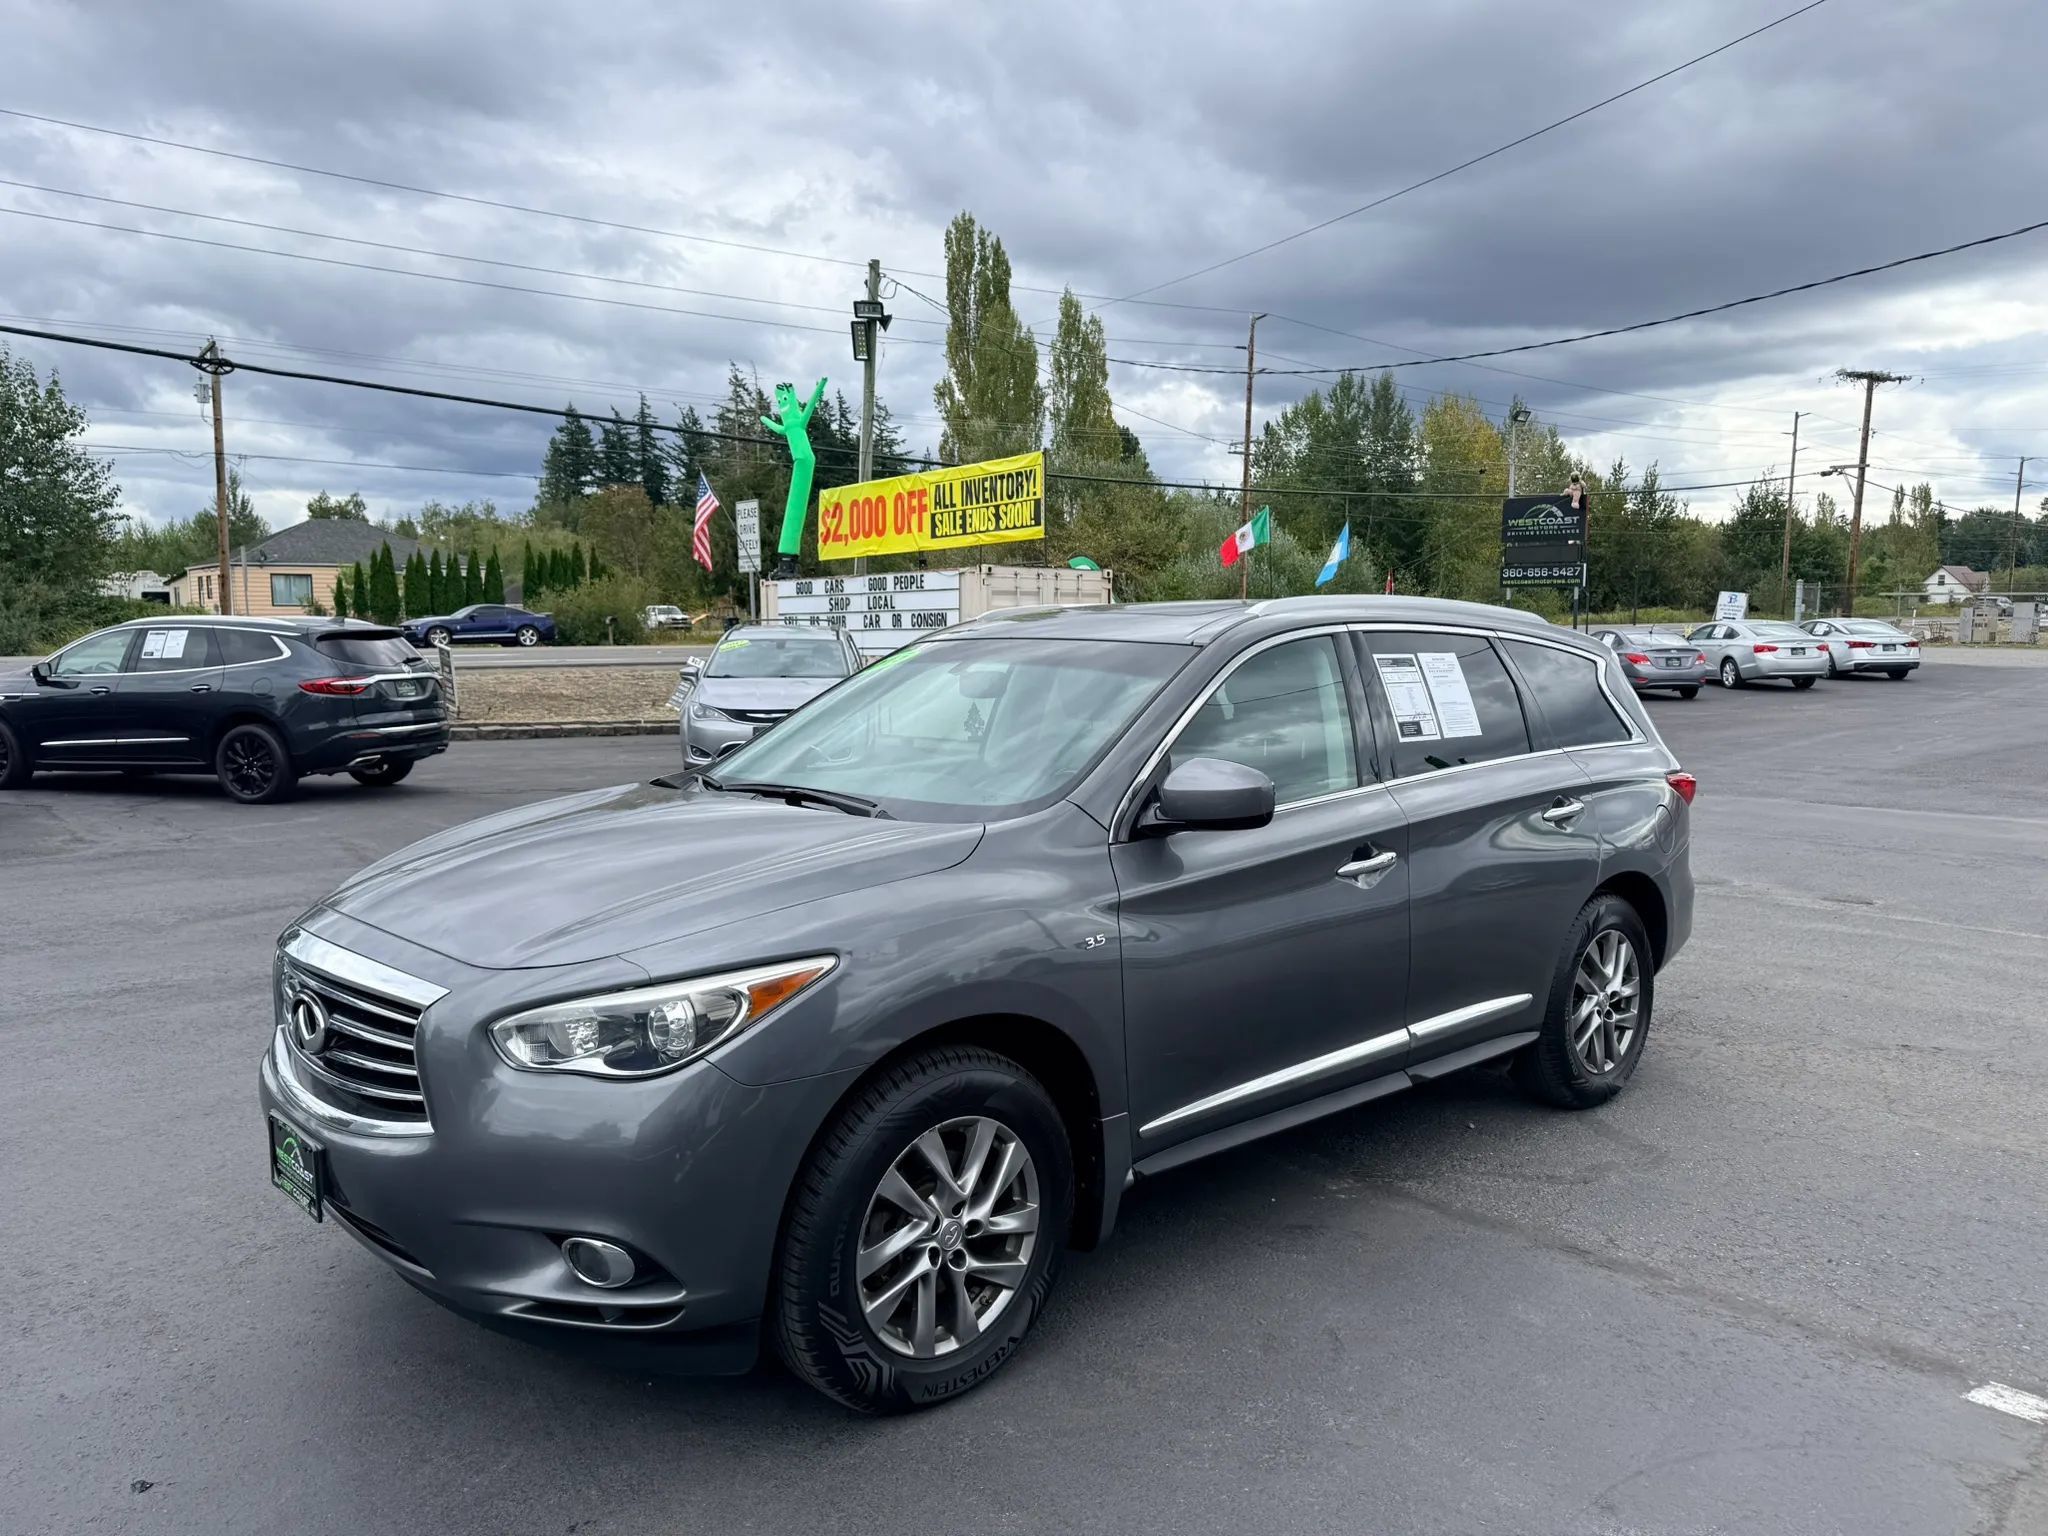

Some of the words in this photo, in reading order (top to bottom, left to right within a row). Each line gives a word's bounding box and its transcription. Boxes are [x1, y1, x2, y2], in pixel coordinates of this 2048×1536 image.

[934, 483, 956, 511] ALL
[960, 468, 1037, 507] INVENTORY!
[737, 507, 757, 519] PLEASE
[820, 495, 887, 546] $2,000
[893, 488, 928, 535] OFF
[935, 509, 963, 537] SALE
[965, 506, 996, 533] ENDS
[999, 500, 1036, 530] SOON!
[1508, 516, 1580, 526] WESTCOAST
[795, 581, 813, 595] GOOD
[824, 579, 845, 594] CARS
[868, 577, 888, 592] GOOD
[893, 574, 925, 590] PEOPLE
[828, 597, 851, 612] SHOP
[867, 595, 896, 610] LOCAL
[863, 614, 881, 629] CAR
[891, 613, 902, 628] OR
[910, 612, 948, 628] CONSIGN
